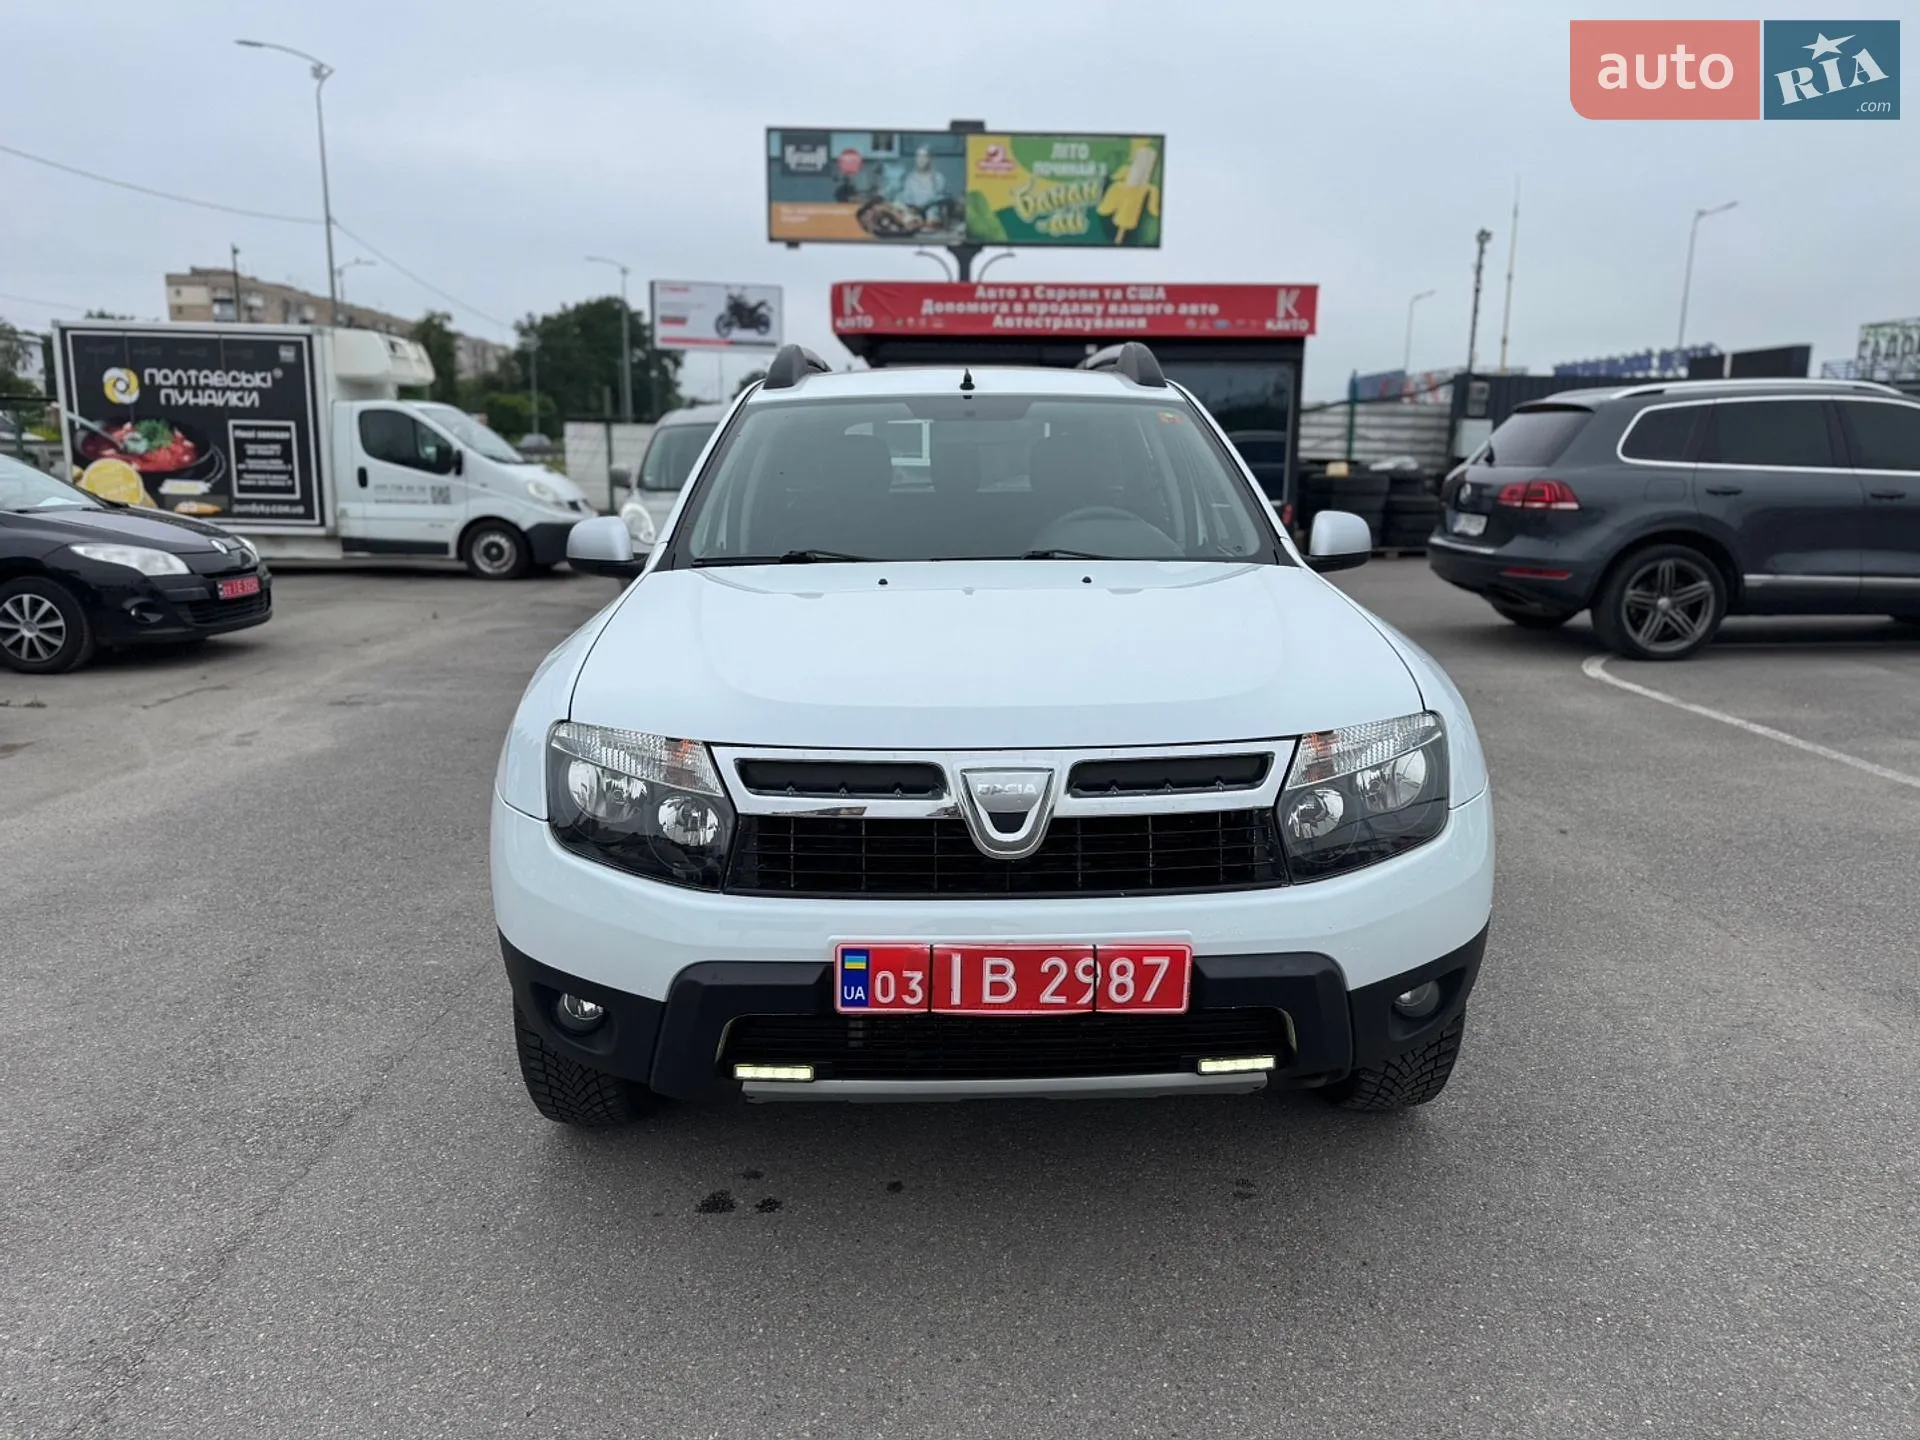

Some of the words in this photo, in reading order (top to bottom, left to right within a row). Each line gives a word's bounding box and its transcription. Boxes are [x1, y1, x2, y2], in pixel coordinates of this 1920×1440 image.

[975, 286, 1016, 299] Авто
[920, 299, 1008, 315] Допомога
[992, 315, 1148, 332] Автострахування
[143, 367, 273, 388] ПОЛТАВСЬКІ
[159, 388, 260, 408] ПУНДИКИ
[977, 783, 1037, 795] DACIA
[874, 970, 924, 1006] 03
[1039, 956, 1171, 1005] 2987
[843, 986, 866, 1001] UA
